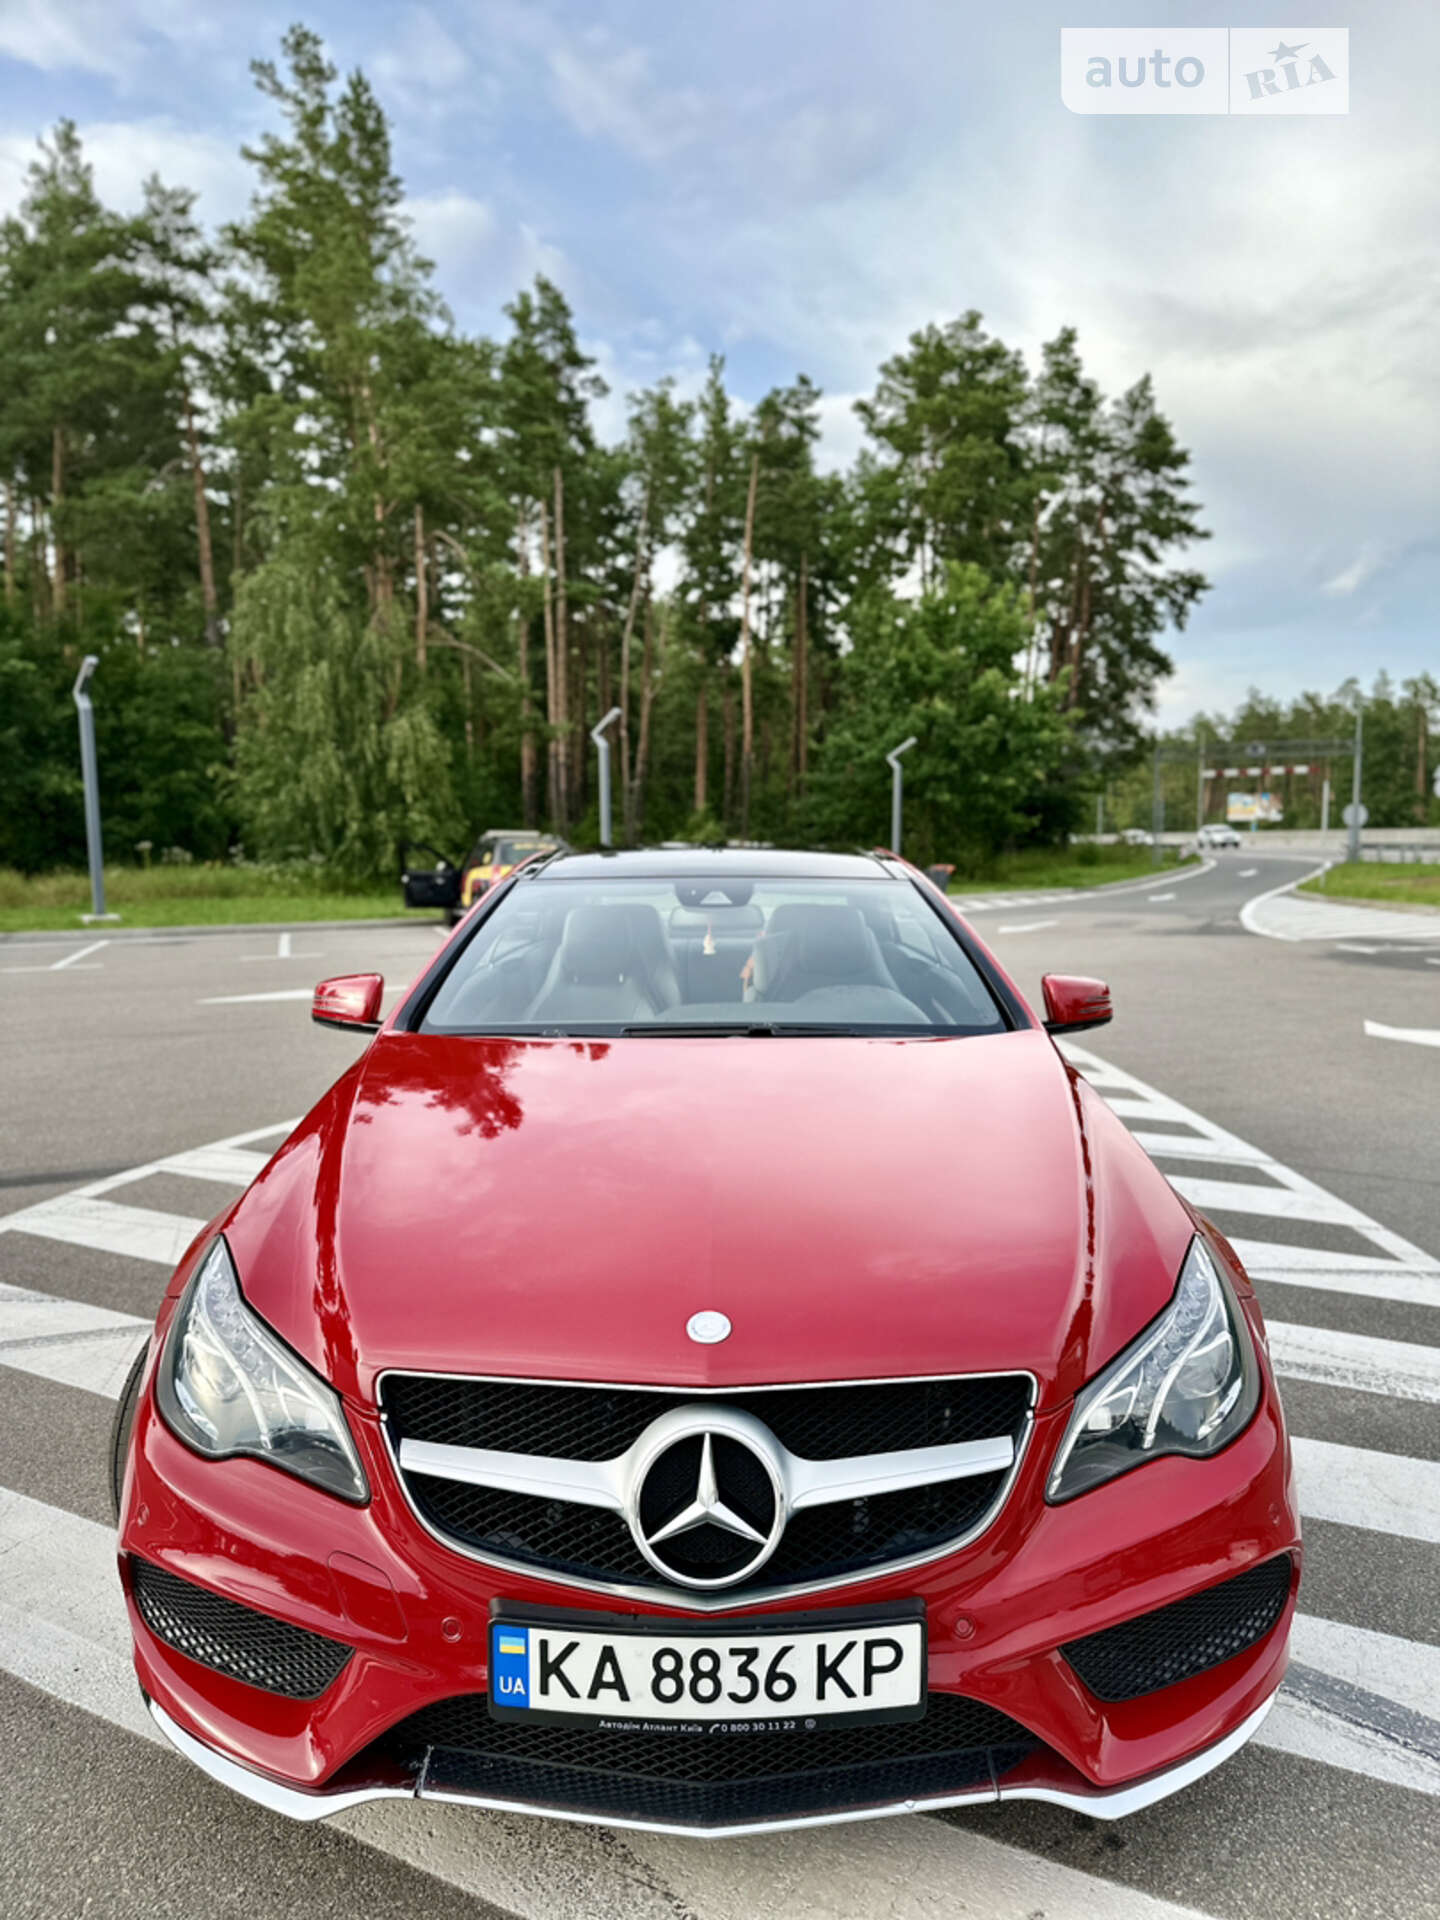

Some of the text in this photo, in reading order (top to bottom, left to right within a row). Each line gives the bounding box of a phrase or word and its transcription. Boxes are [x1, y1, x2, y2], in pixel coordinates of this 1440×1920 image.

[539, 1638, 904, 1704] KA 8836 KP
[499, 1675, 526, 1695] UA
[642, 1722, 678, 1732] Атлант
[721, 1724, 728, 1732] 0
[730, 1723, 750, 1732] 800
[752, 1722, 765, 1732] 30
[768, 1722, 780, 1731] 11
[783, 1720, 796, 1730] 22
